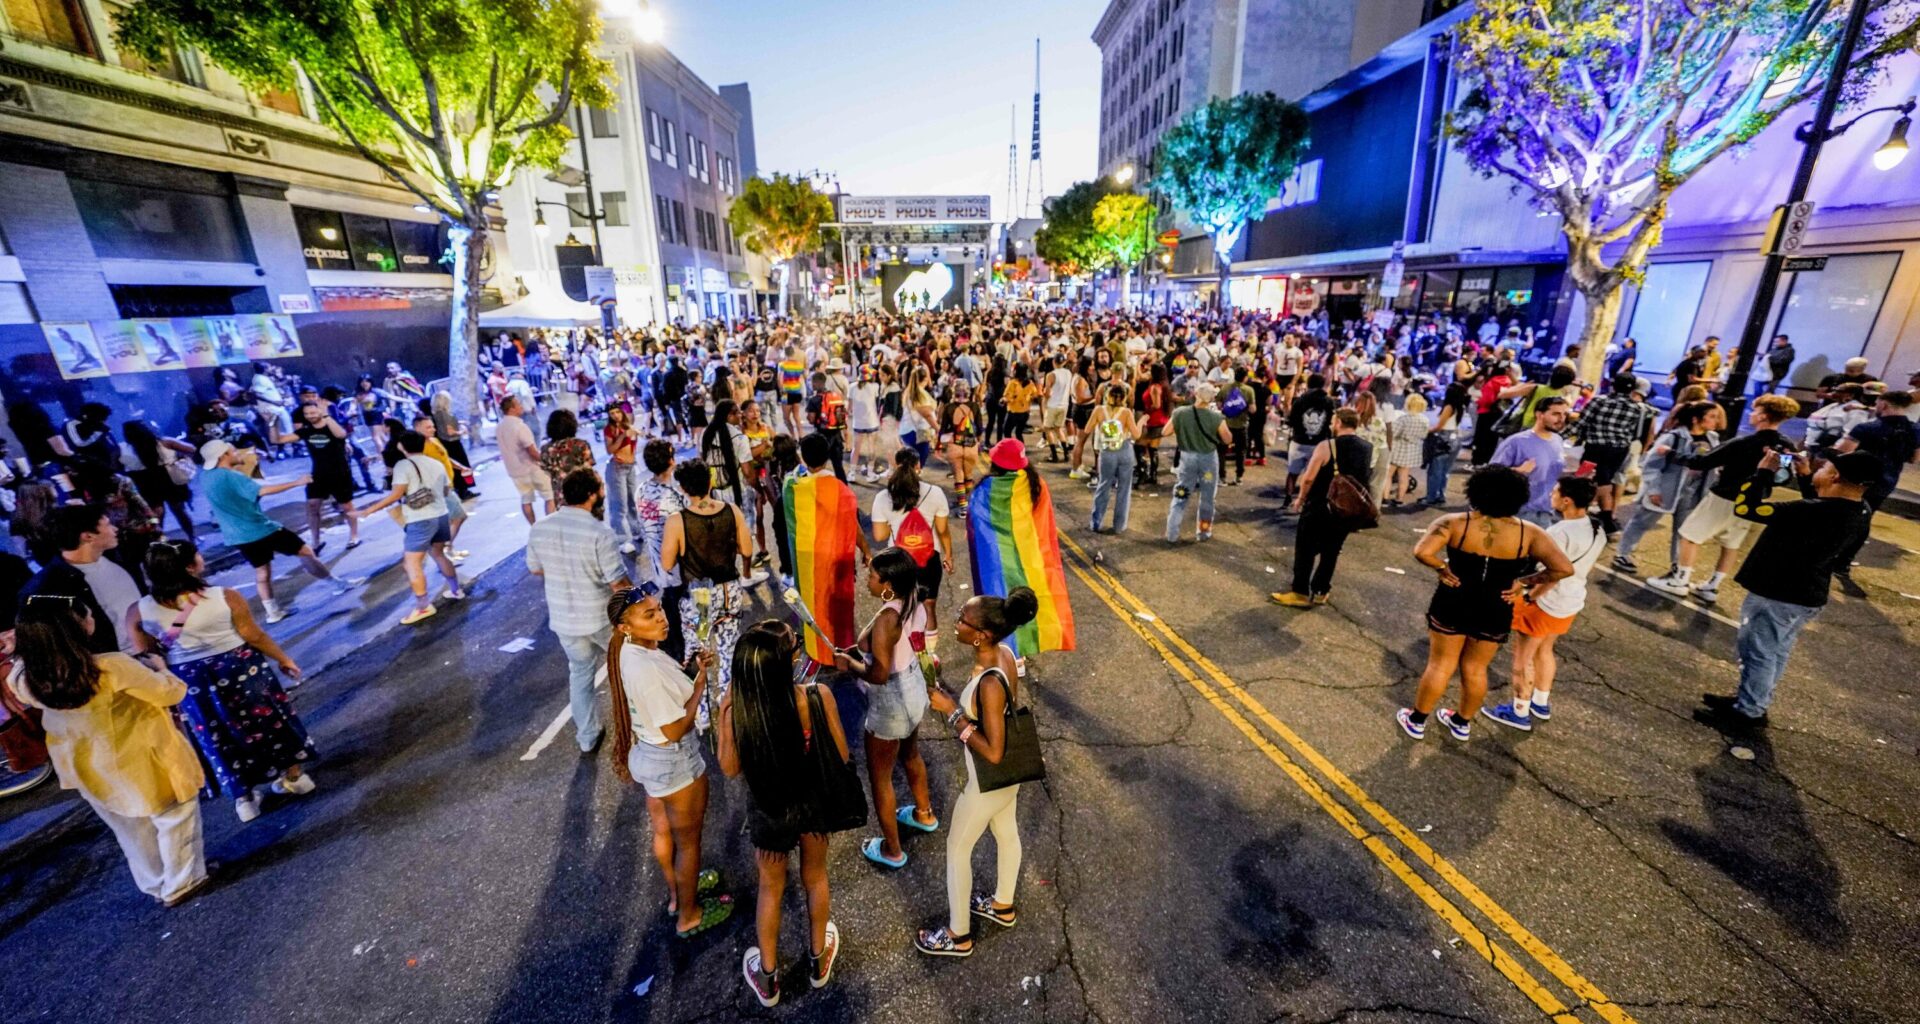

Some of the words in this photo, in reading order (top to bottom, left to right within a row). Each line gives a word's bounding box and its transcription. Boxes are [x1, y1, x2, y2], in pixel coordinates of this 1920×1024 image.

[845, 207, 886, 219] PRIDE
[896, 207, 937, 219] PRIDE
[946, 207, 988, 218] PRIDE
[303, 247, 349, 260] COCKTAILS
[110, 348, 139, 359] YOU
